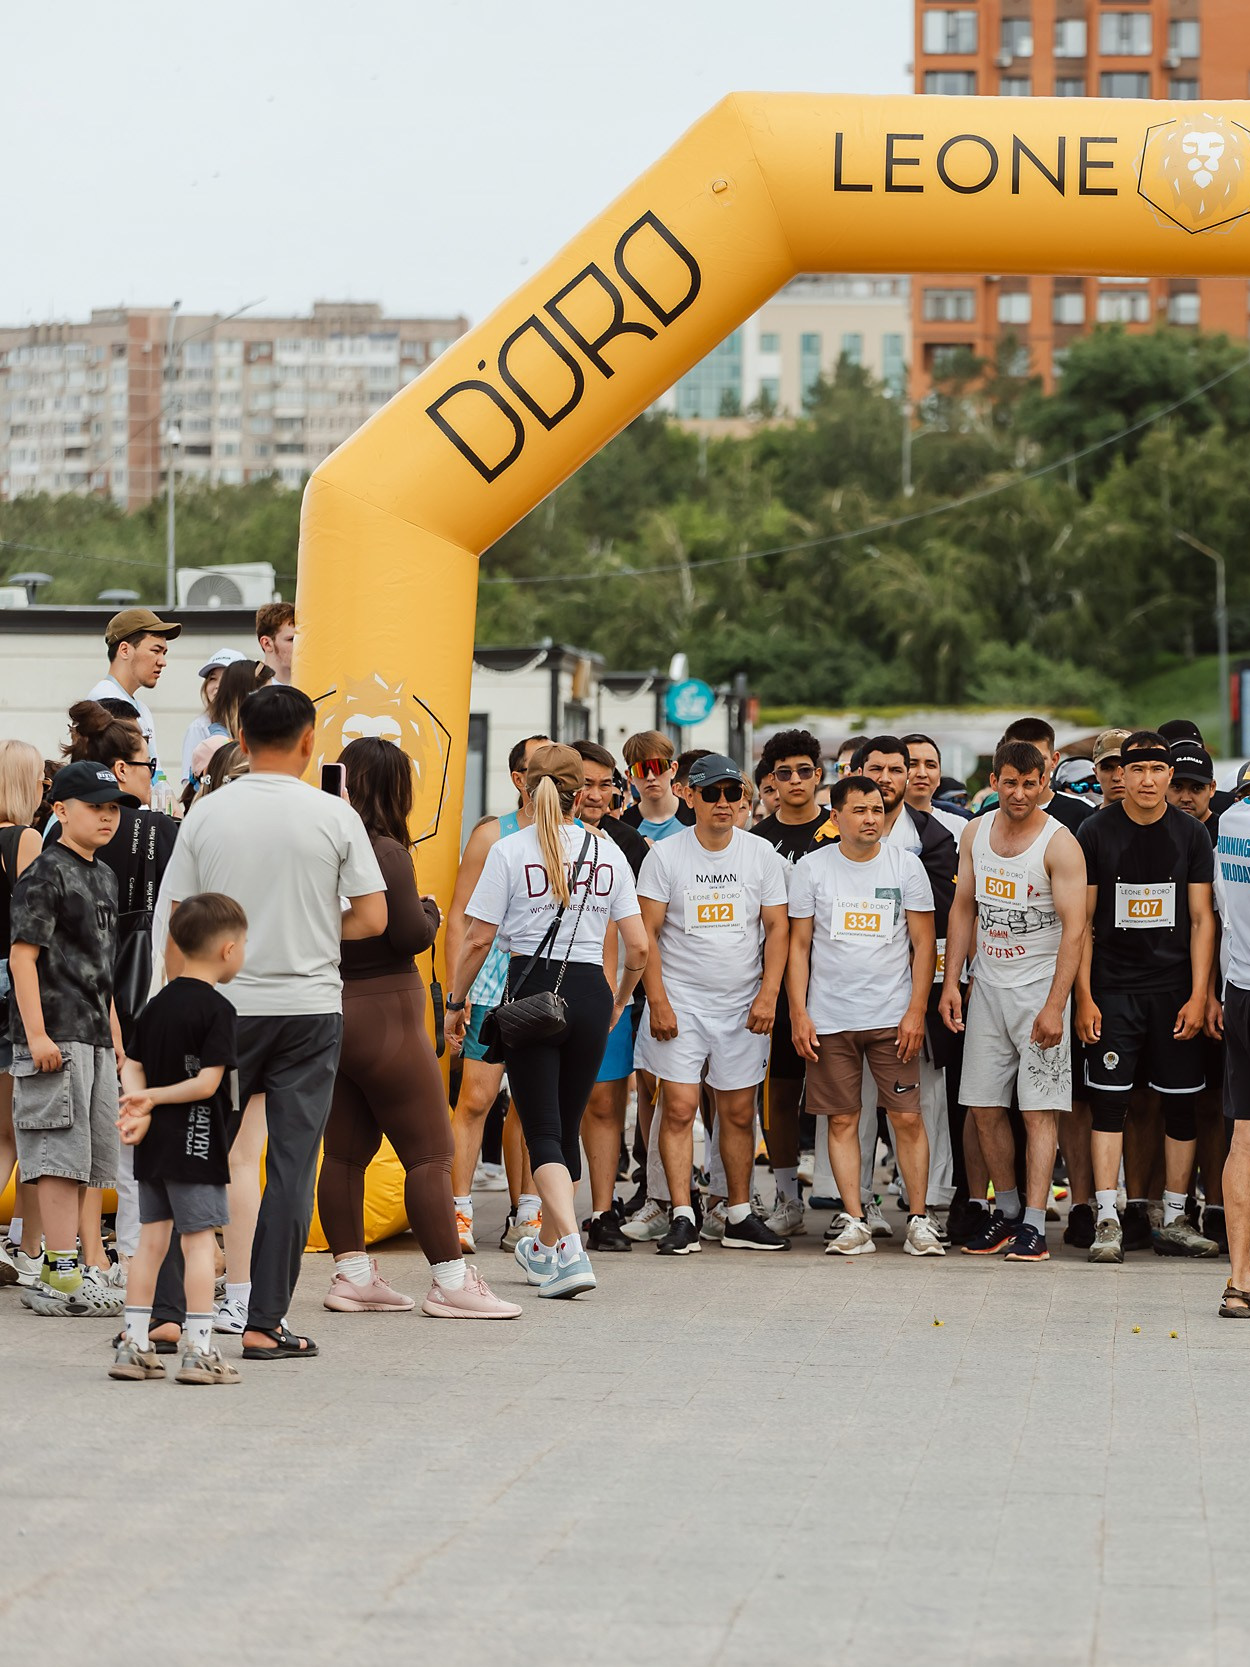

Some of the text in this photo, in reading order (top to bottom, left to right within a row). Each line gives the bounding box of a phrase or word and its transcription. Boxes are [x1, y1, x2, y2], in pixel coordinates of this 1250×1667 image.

[833, 132, 1118, 197] LEONE
[425, 209, 701, 484] D'ORO
[131, 818, 142, 854] Calvin Klein
[147, 826, 156, 860] Calvin Klein
[696, 873, 737, 883] NAIMAN
[980, 865, 997, 873] LEONE
[988, 879, 1011, 897] 501
[701, 905, 730, 920] 412
[1131, 902, 1159, 915] 407
[848, 914, 877, 929] 334
[989, 929, 1008, 938] AGAIN
[982, 941, 1026, 959] ROUND
[186, 1125, 194, 1155] TOUR
